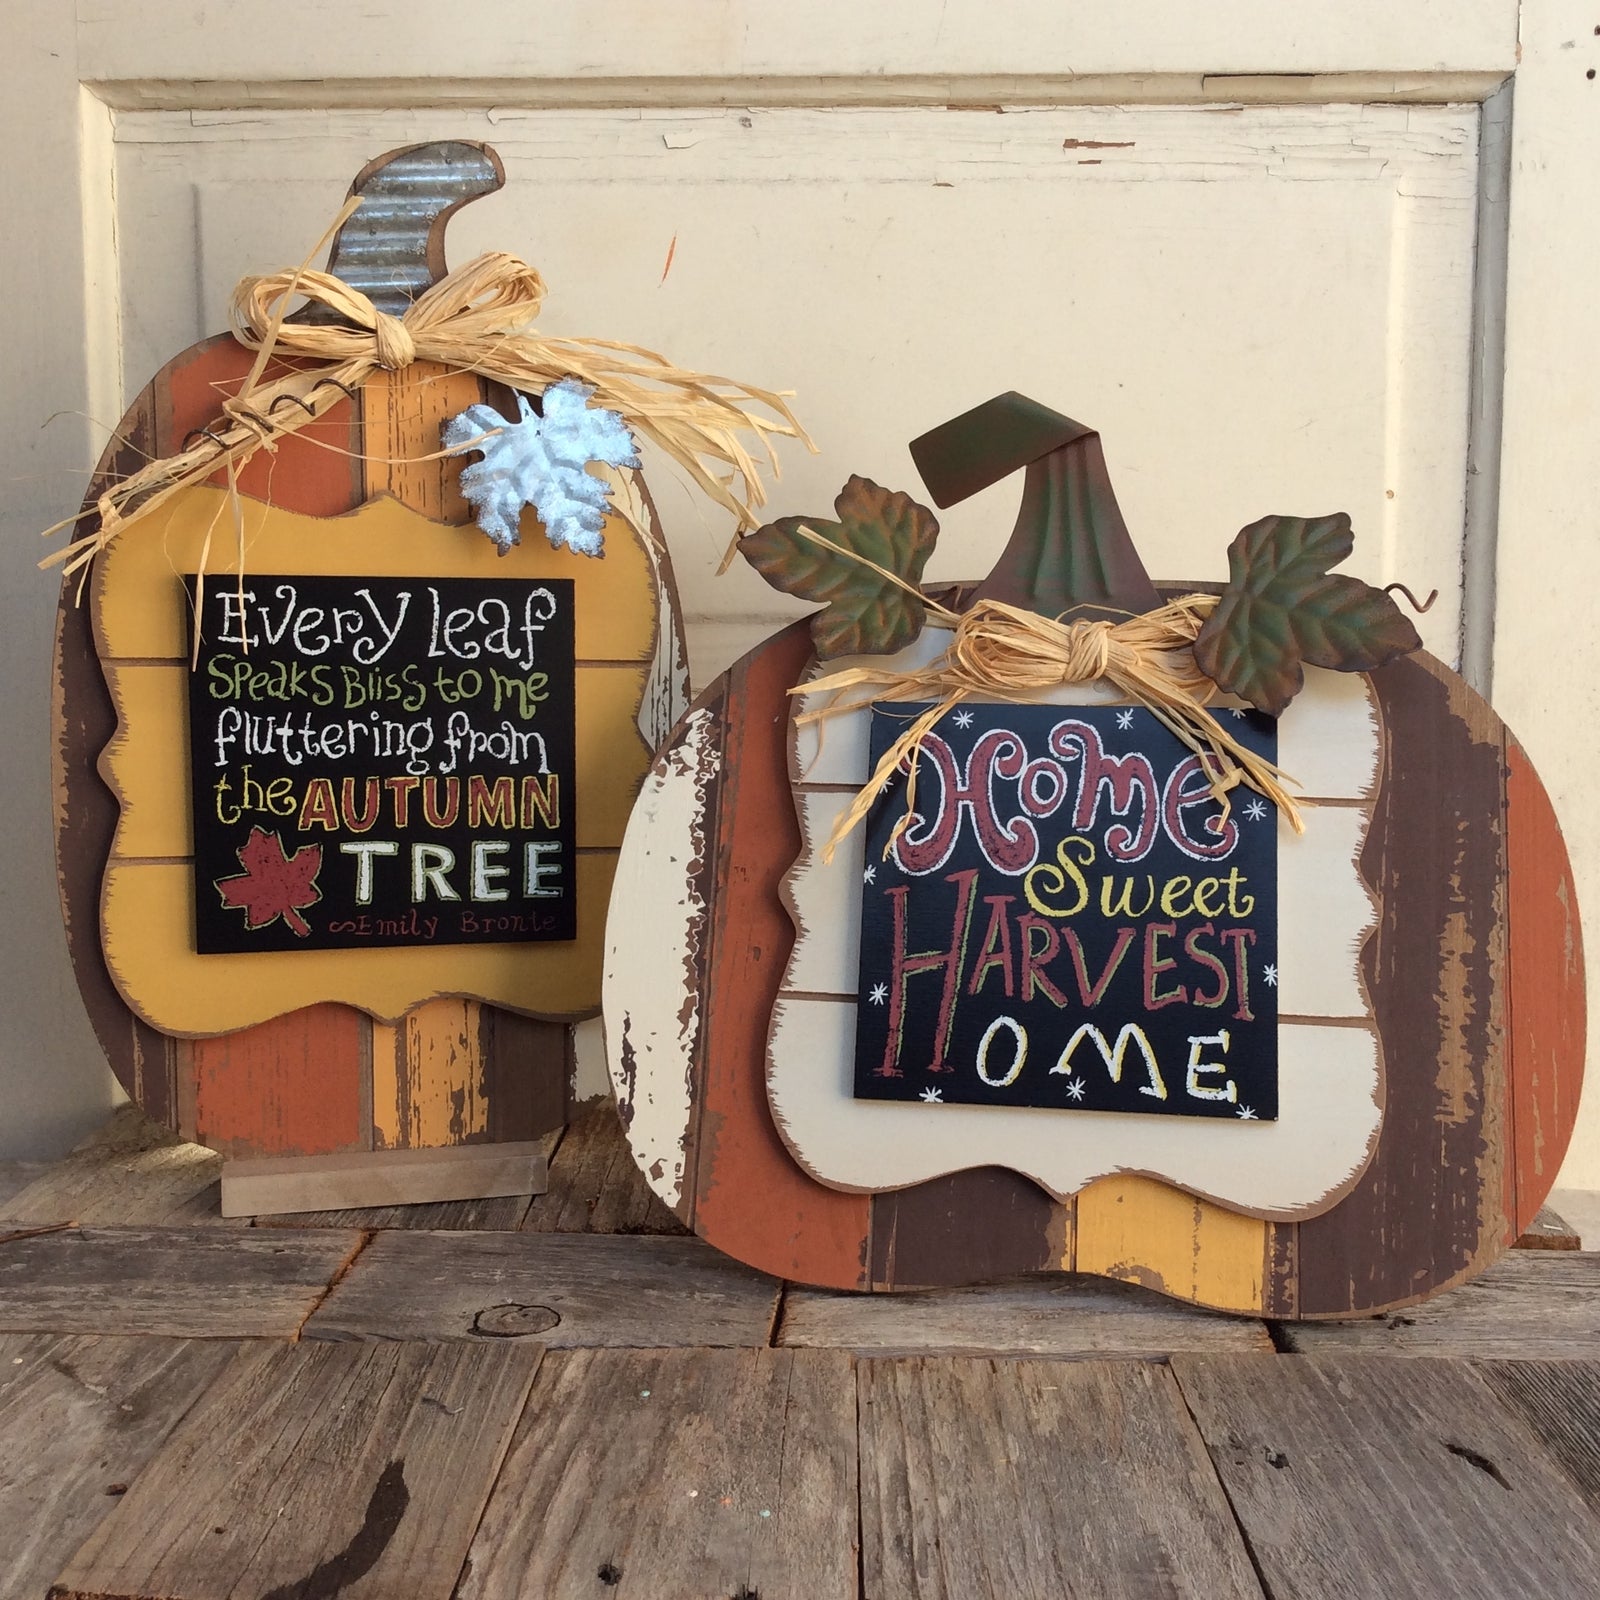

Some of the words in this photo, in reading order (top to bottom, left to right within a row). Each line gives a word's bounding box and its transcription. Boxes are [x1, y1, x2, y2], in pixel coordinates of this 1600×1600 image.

[215, 584, 412, 665] Every
[427, 587, 557, 670] leaf
[434, 665, 482, 704] to
[489, 666, 551, 720] me
[213, 705, 435, 775] fluttering
[437, 710, 552, 774] from
[213, 764, 297, 825] the
[297, 774, 561, 834] AUTUMN
[340, 840, 564, 906] TREE
[1023, 836, 1255, 918] Sweet
[872, 868, 1257, 1077] HARVEST
